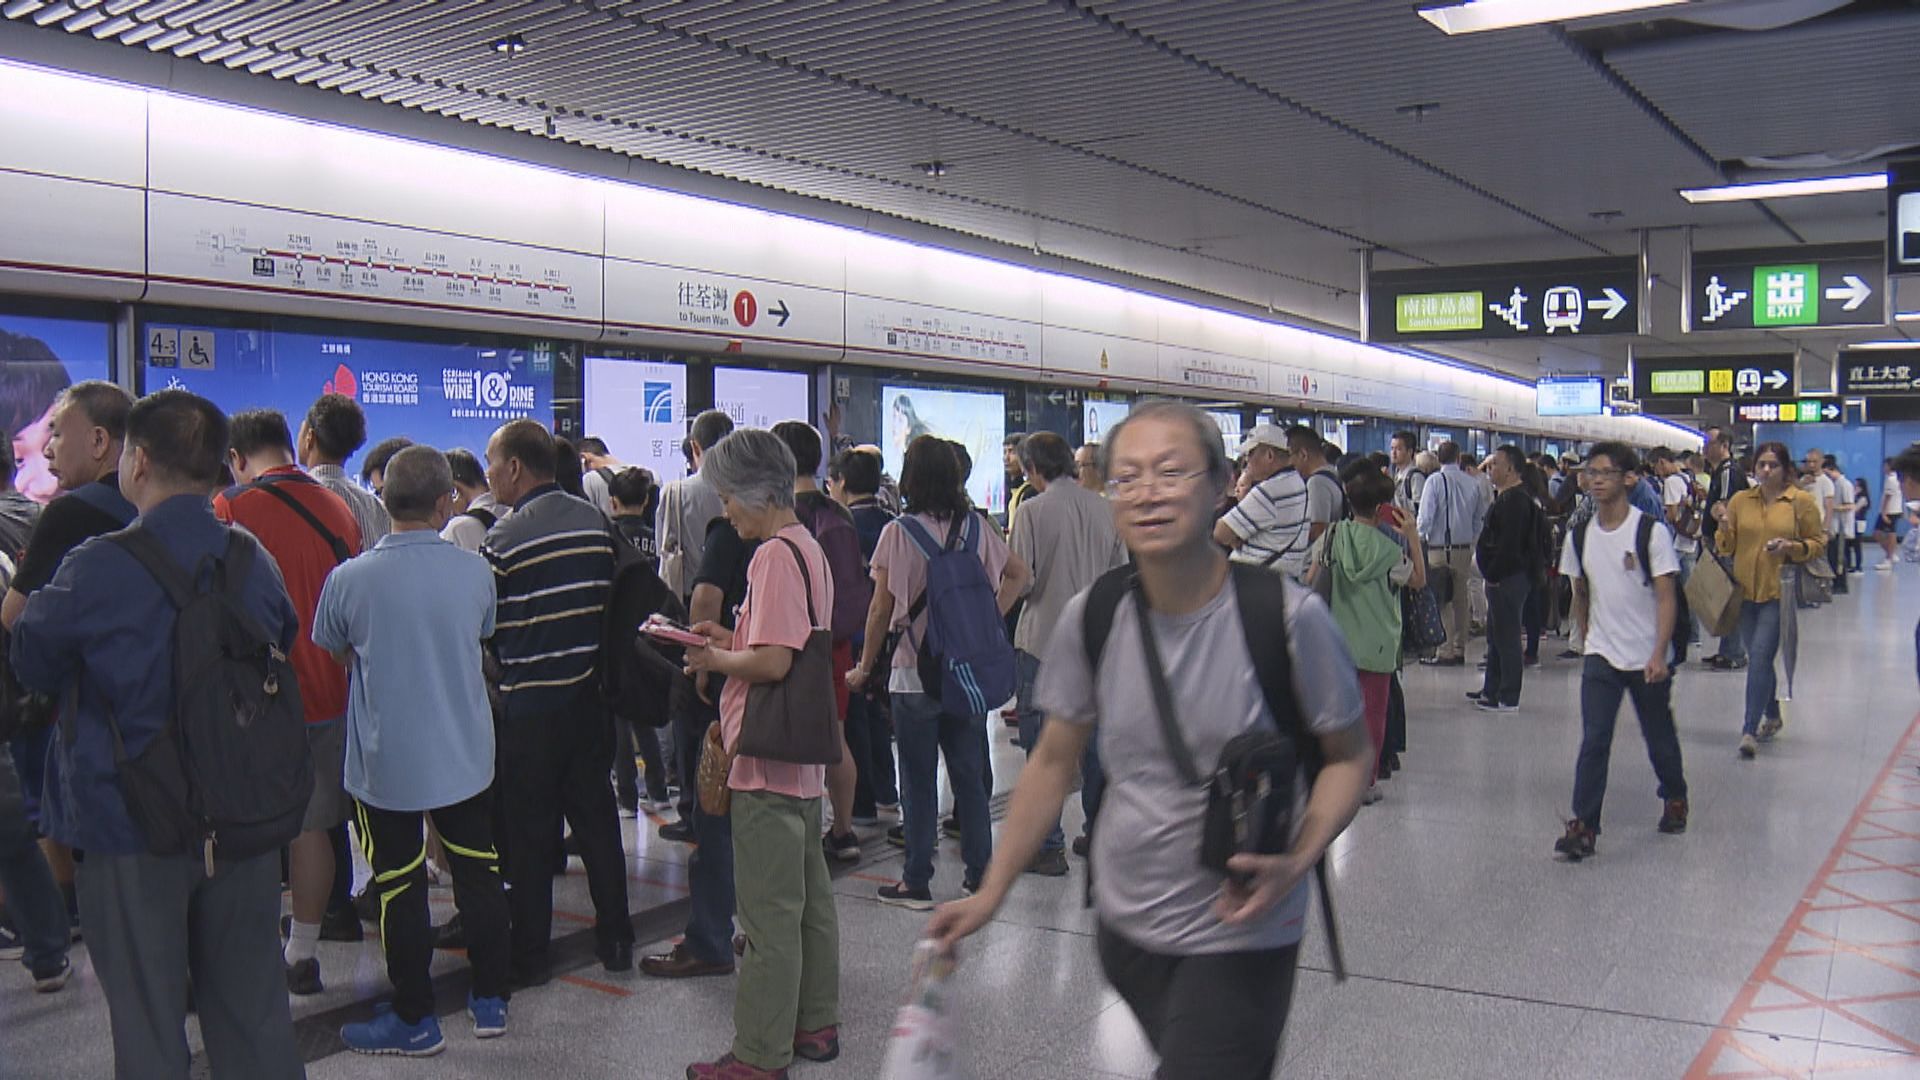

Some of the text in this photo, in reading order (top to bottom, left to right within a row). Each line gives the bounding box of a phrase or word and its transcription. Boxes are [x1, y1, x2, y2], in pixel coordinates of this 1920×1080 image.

[1767, 271, 1804, 304] 出
[679, 281, 728, 311] 往荃灣
[742, 297, 748, 321] 1
[1767, 304, 1802, 318] EXIT
[680, 312, 729, 326] to Tsuen Wan
[1408, 317, 1431, 328] South
[1458, 314, 1478, 326] Line
[151, 332, 176, 354] 4-3
[361, 370, 418, 384] HONG KONG
[362, 382, 418, 395] TOURISM BOARD
[443, 383, 473, 400] WINE
[509, 386, 535, 401] DINE
